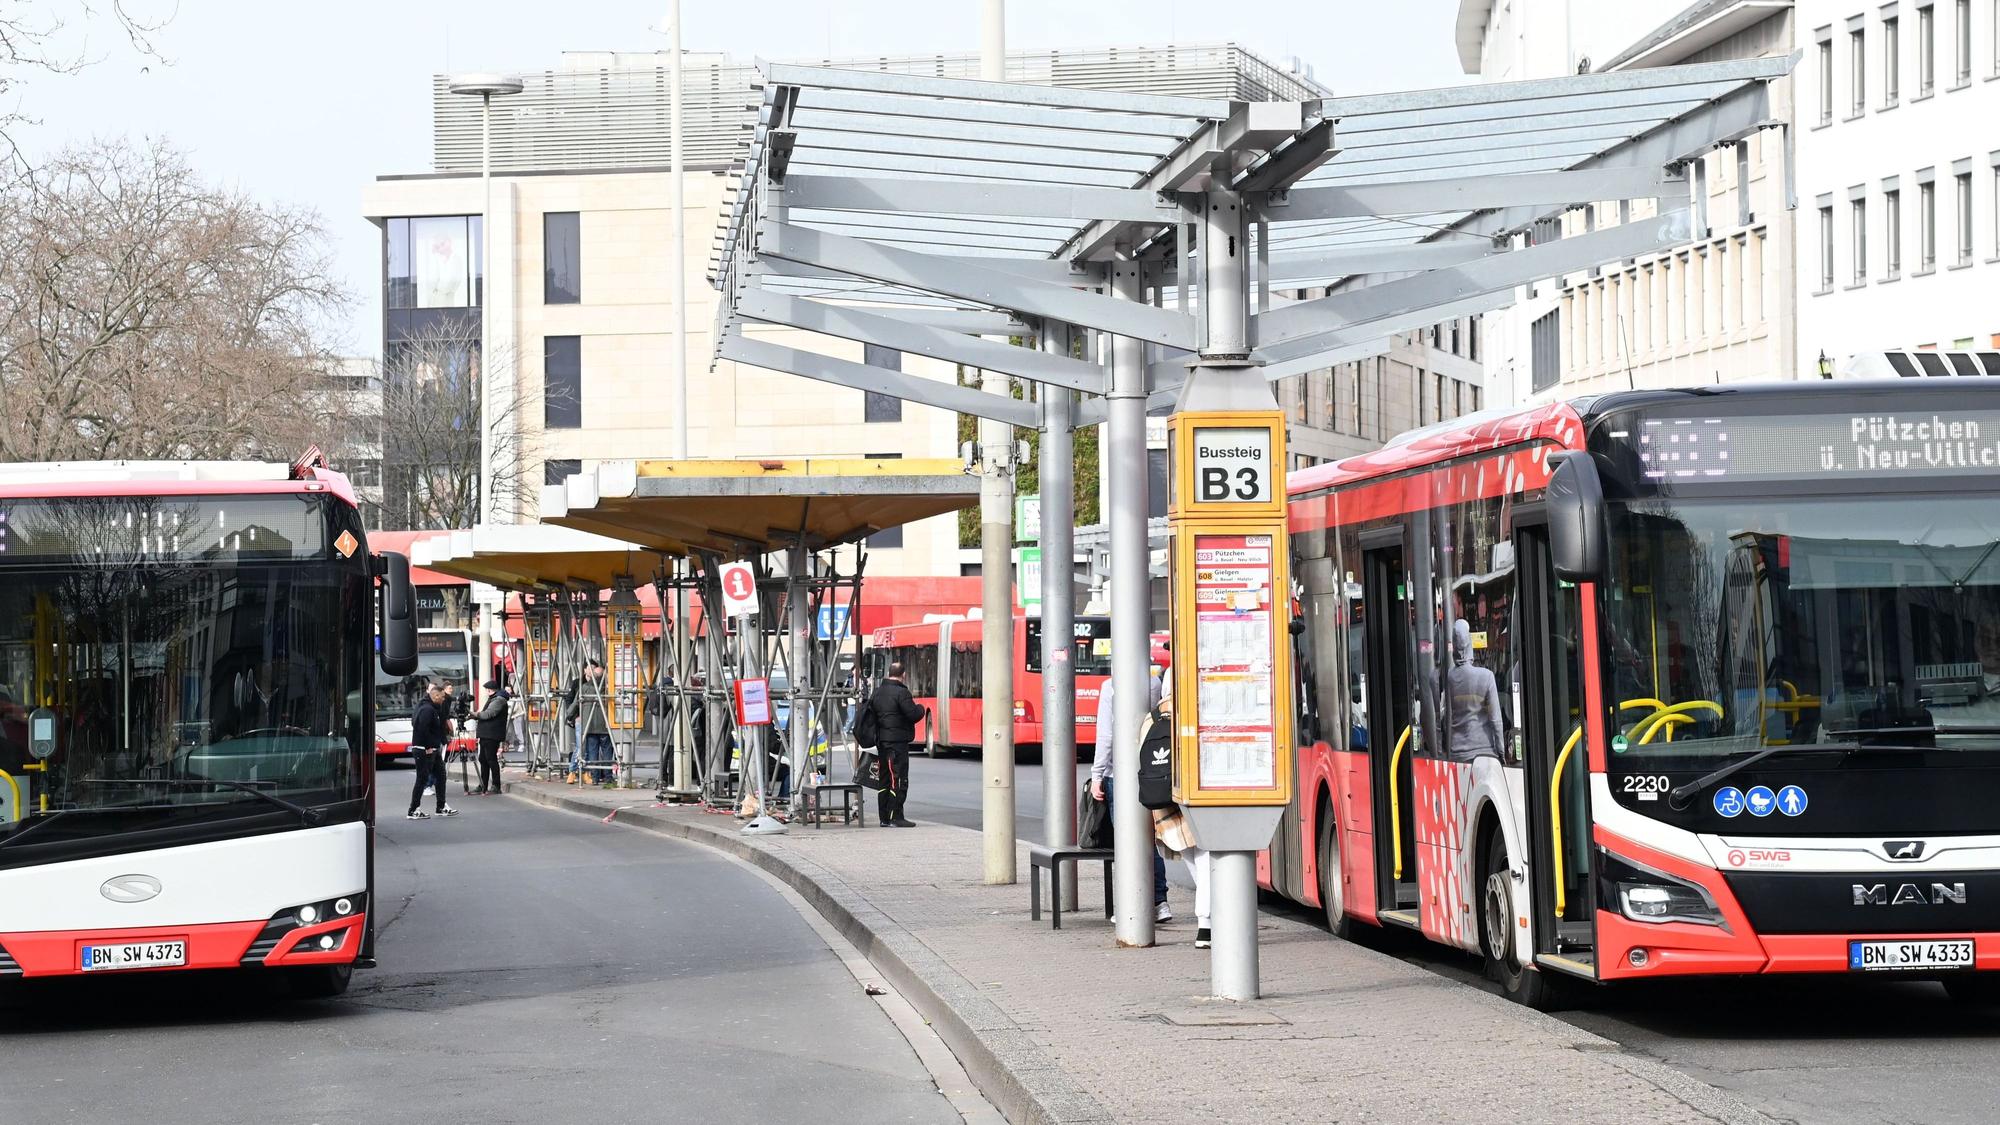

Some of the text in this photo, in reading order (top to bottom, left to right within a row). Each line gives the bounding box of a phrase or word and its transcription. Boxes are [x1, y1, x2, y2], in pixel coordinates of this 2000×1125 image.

[1852, 415, 1979, 442] Pützchen
[1199, 446, 1262, 460] Bussteig
[1858, 440, 2000, 469] Neu-Vilic
[1202, 467, 1260, 501] B3
[1198, 569, 1239, 580] 608 Gielgen
[1623, 775, 1670, 793] 2230
[1749, 850, 1791, 861] SWB
[1852, 882, 1967, 905] MAN
[93, 948, 112, 964] BN
[123, 946, 142, 962] SW
[146, 944, 182, 960] 4373
[1863, 945, 1886, 964] BN
[1900, 944, 1922, 963] SW
[1926, 943, 1971, 962] 4333
